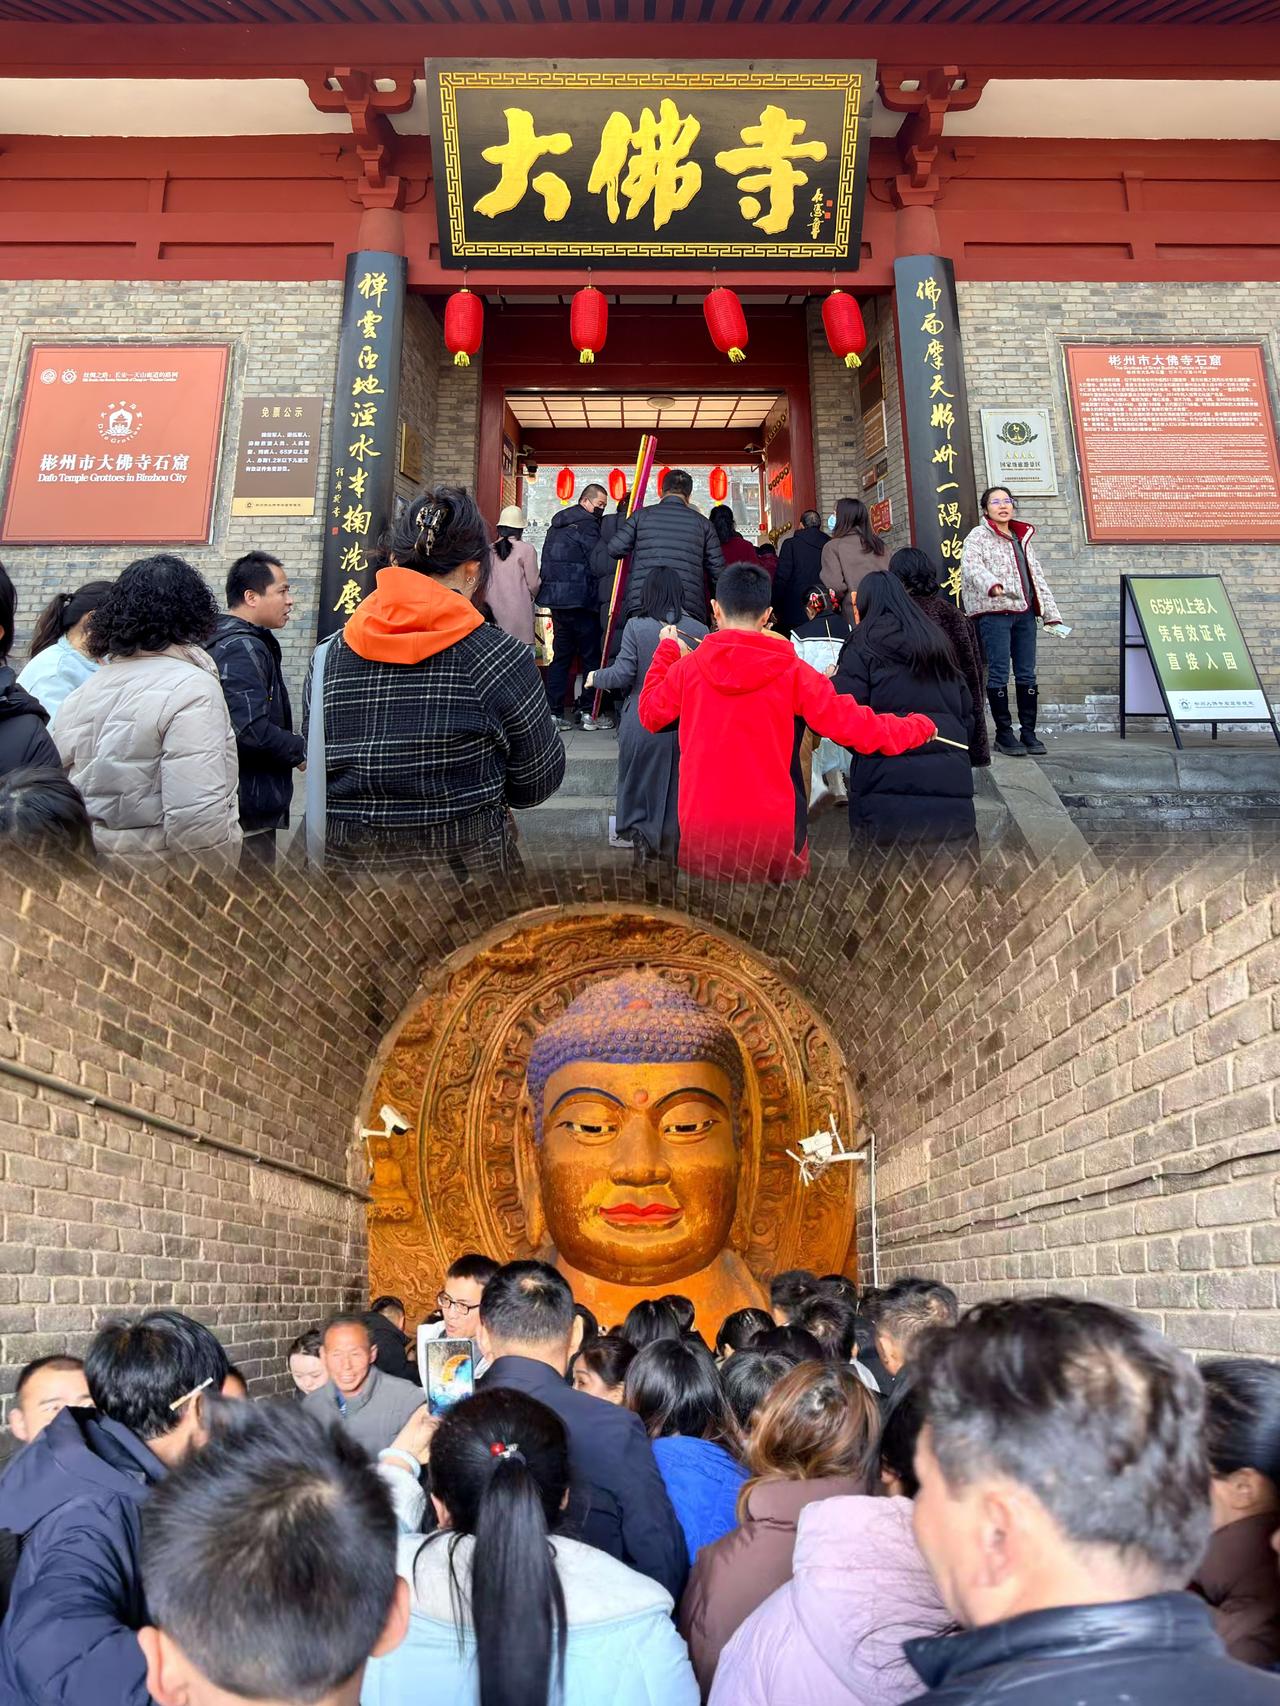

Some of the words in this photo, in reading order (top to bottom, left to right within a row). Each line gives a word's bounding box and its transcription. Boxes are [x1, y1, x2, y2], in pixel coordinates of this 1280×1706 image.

[473, 97, 828, 235] 大佛寺
[1108, 354, 1222, 366] 彬州市大佛寺石窟
[261, 406, 304, 418] 免票公示
[40, 453, 190, 471] 彬州市大佛寺石窟
[38, 473, 58, 482] Dafo
[59, 473, 88, 484] Temple
[90, 473, 125, 482] Grottoes
[126, 473, 135, 481] in
[136, 473, 169, 482] Binzhou
[170, 473, 188, 483] City
[1150, 597, 1218, 616] 65岁以上老人
[1158, 624, 1227, 642] 凭有效证件
[1166, 652, 1237, 670] 直接入园
